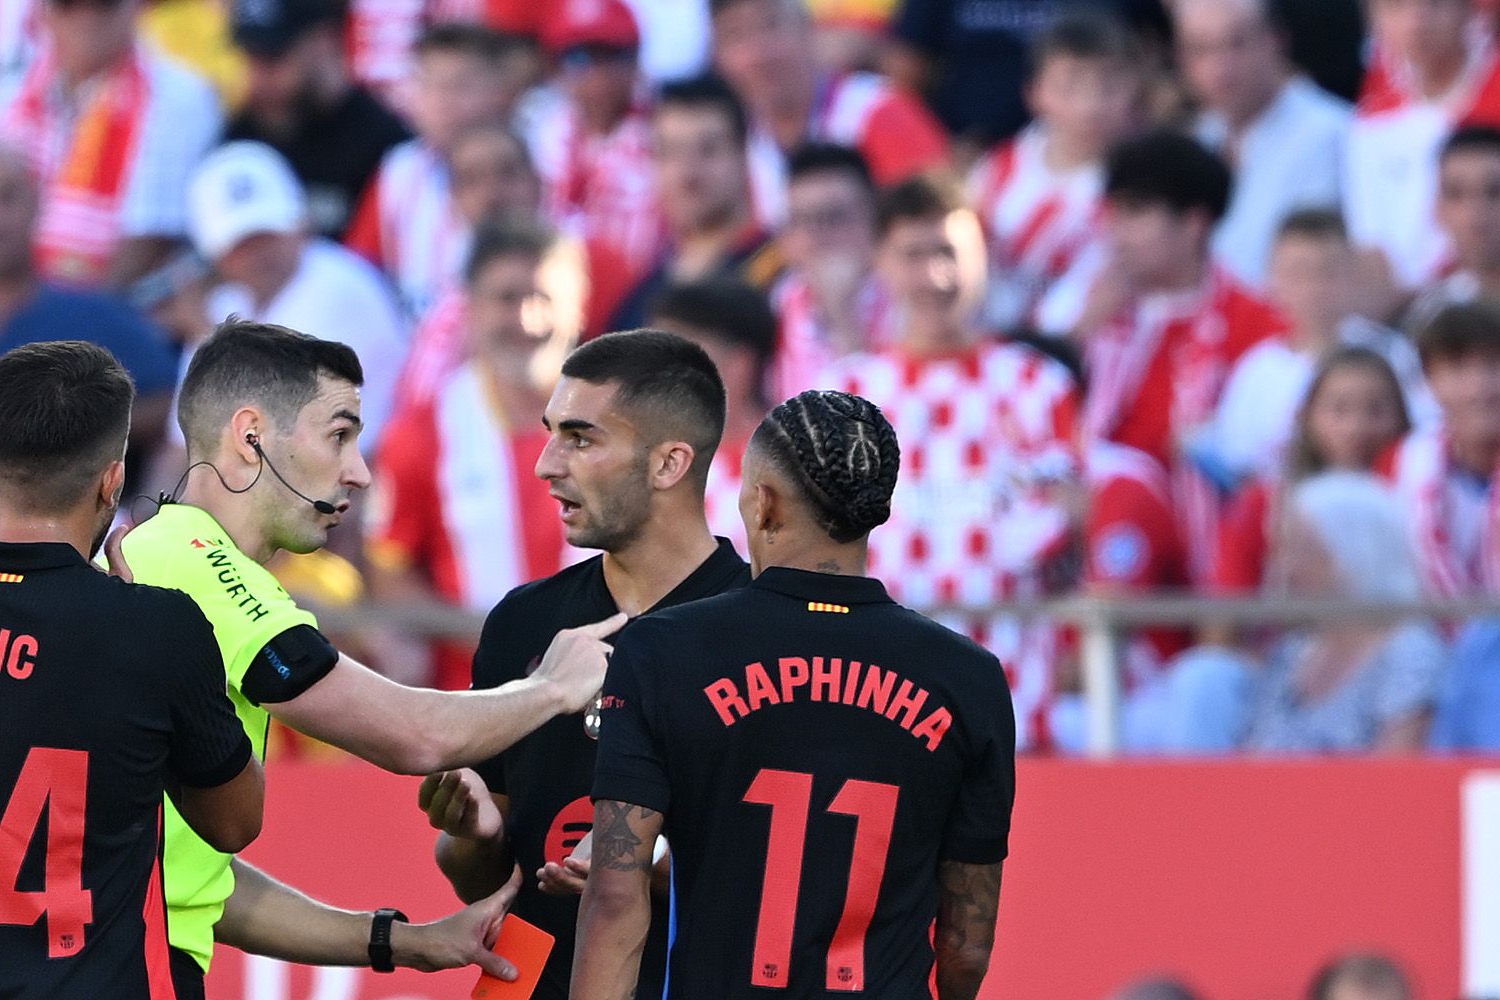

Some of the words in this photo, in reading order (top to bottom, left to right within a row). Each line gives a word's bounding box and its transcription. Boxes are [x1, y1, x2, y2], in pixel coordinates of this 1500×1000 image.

[206, 549, 269, 622] WÜRTH
[703, 656, 953, 752] RAPHINHA
[741, 768, 899, 992] 11
